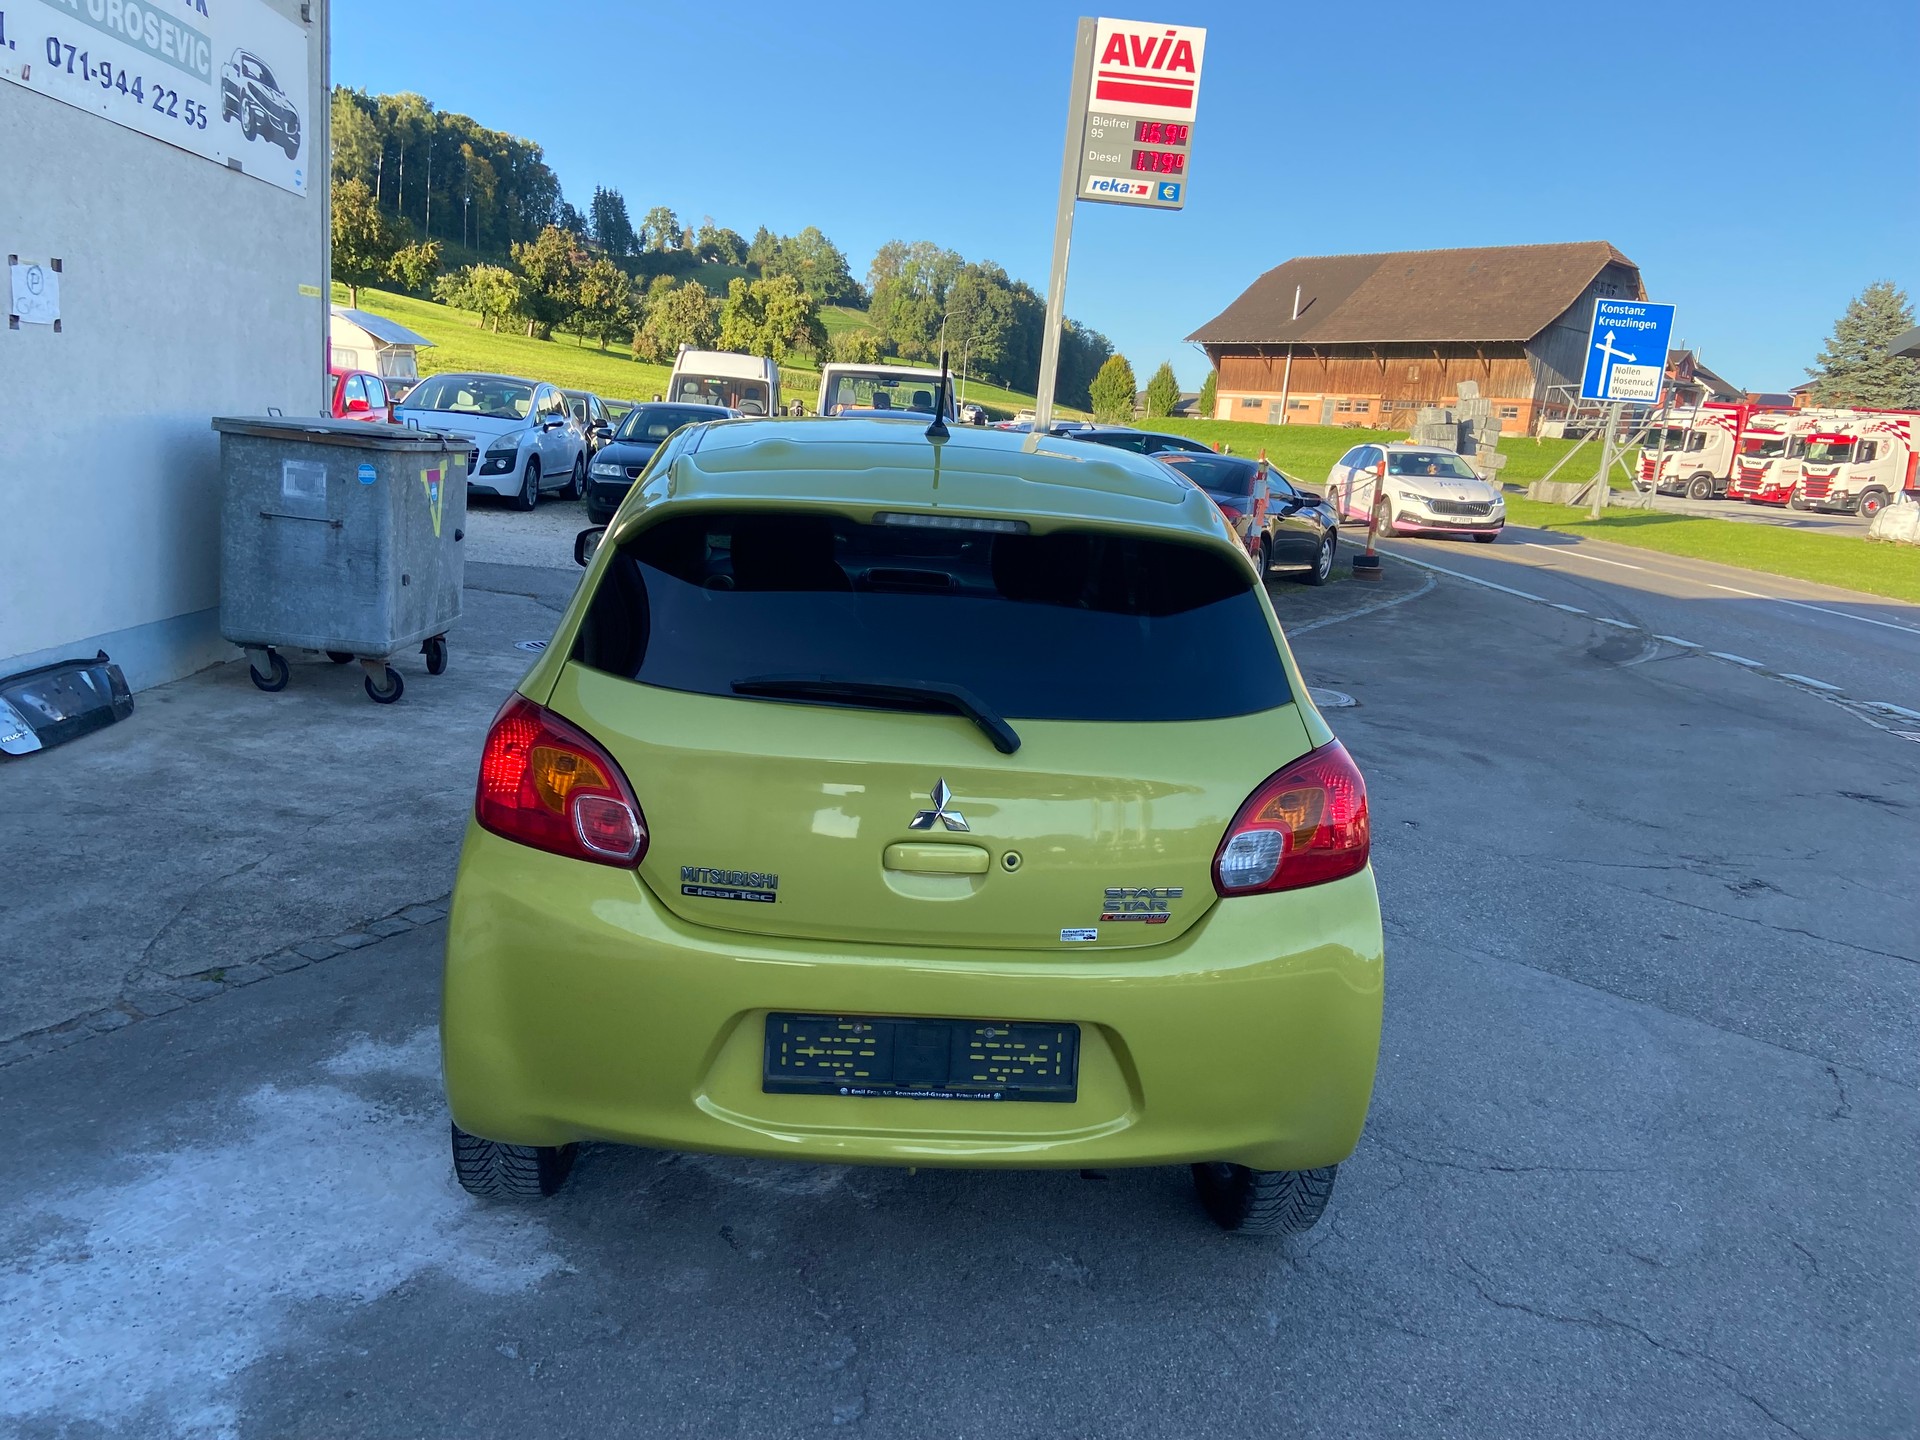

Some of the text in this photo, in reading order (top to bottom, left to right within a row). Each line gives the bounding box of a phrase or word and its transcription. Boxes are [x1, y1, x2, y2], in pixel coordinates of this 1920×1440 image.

[46, 37, 144, 103] 071-944
[152, 85, 178, 118] 22
[185, 99, 207, 129] 55
[1092, 116, 1130, 129] Bleifrei
[1091, 128, 1104, 138] 95
[1088, 150, 1121, 163] Diesel
[1601, 303, 1646, 316] Konstanz
[1598, 316, 1657, 331] Kreuzlingen
[1615, 366, 1641, 376] Nollen
[1613, 376, 1655, 387] Hosenruck
[1612, 386, 1653, 397] Wuppenau
[681, 866, 778, 889] MITSUBISHI
[683, 886, 774, 902] ClearTec
[1104, 887, 1184, 899] SPACE
[1103, 899, 1169, 911] STAR
